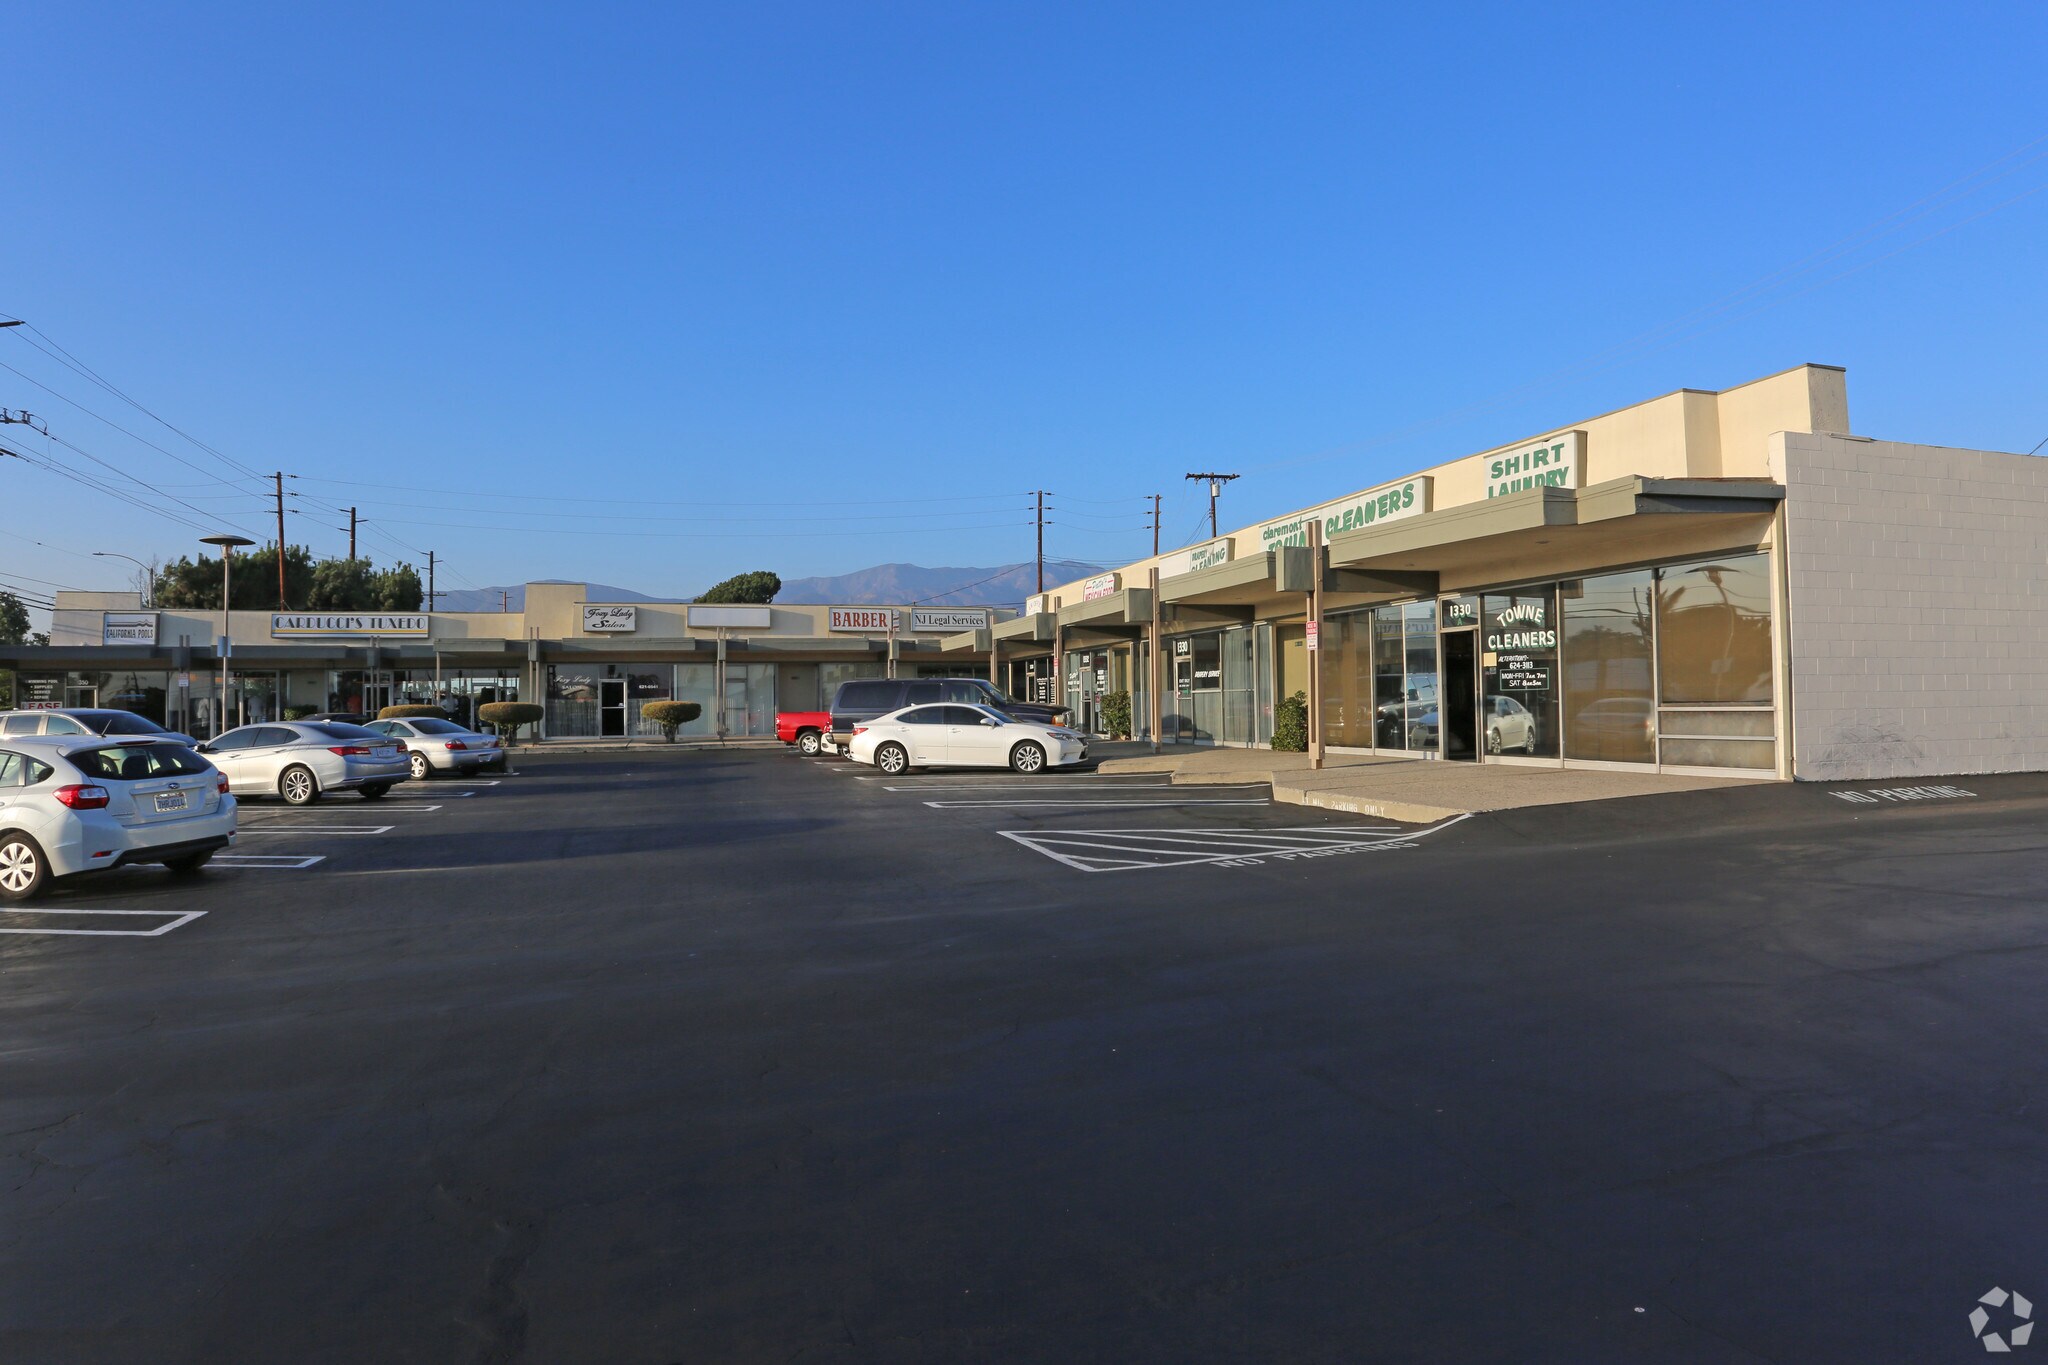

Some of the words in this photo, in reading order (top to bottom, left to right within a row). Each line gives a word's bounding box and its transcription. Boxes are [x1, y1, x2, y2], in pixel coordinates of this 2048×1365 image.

[1491, 443, 1565, 479] SHIRT
[1325, 483, 1414, 540] CLEANERS
[1263, 516, 1303, 540] claremont
[610, 607, 633, 620] Lady
[1449, 603, 1471, 617] 1330
[1496, 604, 1544, 627] TOWNE
[274, 616, 363, 629] CARDUCCI'S
[369, 617, 425, 629] TUXEDO
[592, 619, 626, 628] Salon
[832, 611, 888, 628] BARBER
[915, 614, 926, 625] NJ
[929, 614, 950, 626] Legal
[952, 615, 984, 625] Services
[106, 629, 136, 639] CALIFORNIA
[138, 629, 154, 639] POOLS
[1488, 630, 1556, 650] CLEANERS
[1828, 790, 1879, 803] NO
[1867, 785, 1978, 802] PARKING
[1364, 804, 1385, 816] ONLY
